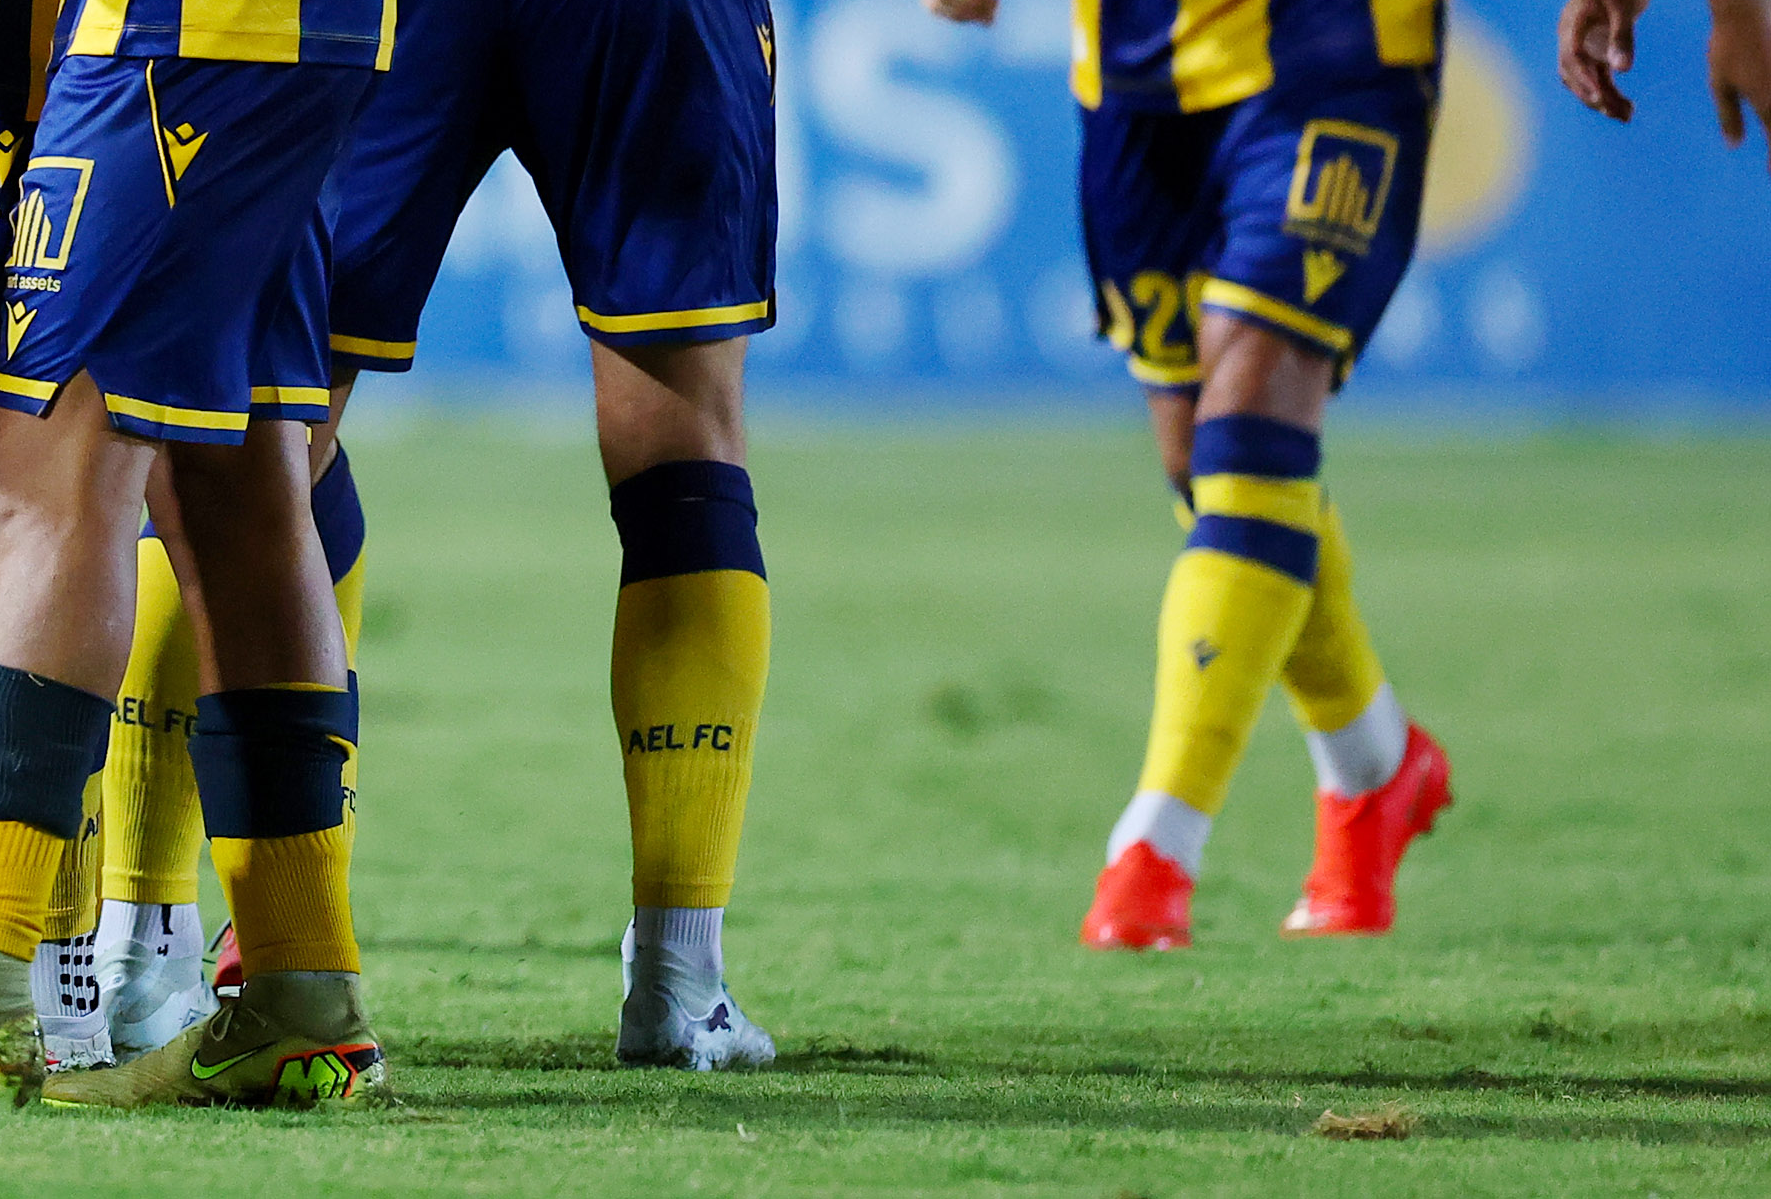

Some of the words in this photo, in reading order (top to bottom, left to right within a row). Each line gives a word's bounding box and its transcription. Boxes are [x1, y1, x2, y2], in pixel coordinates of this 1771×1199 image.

[18, 276, 62, 293] assets
[115, 696, 156, 729] EL
[628, 724, 685, 755] AEL
[692, 723, 733, 751] FC
